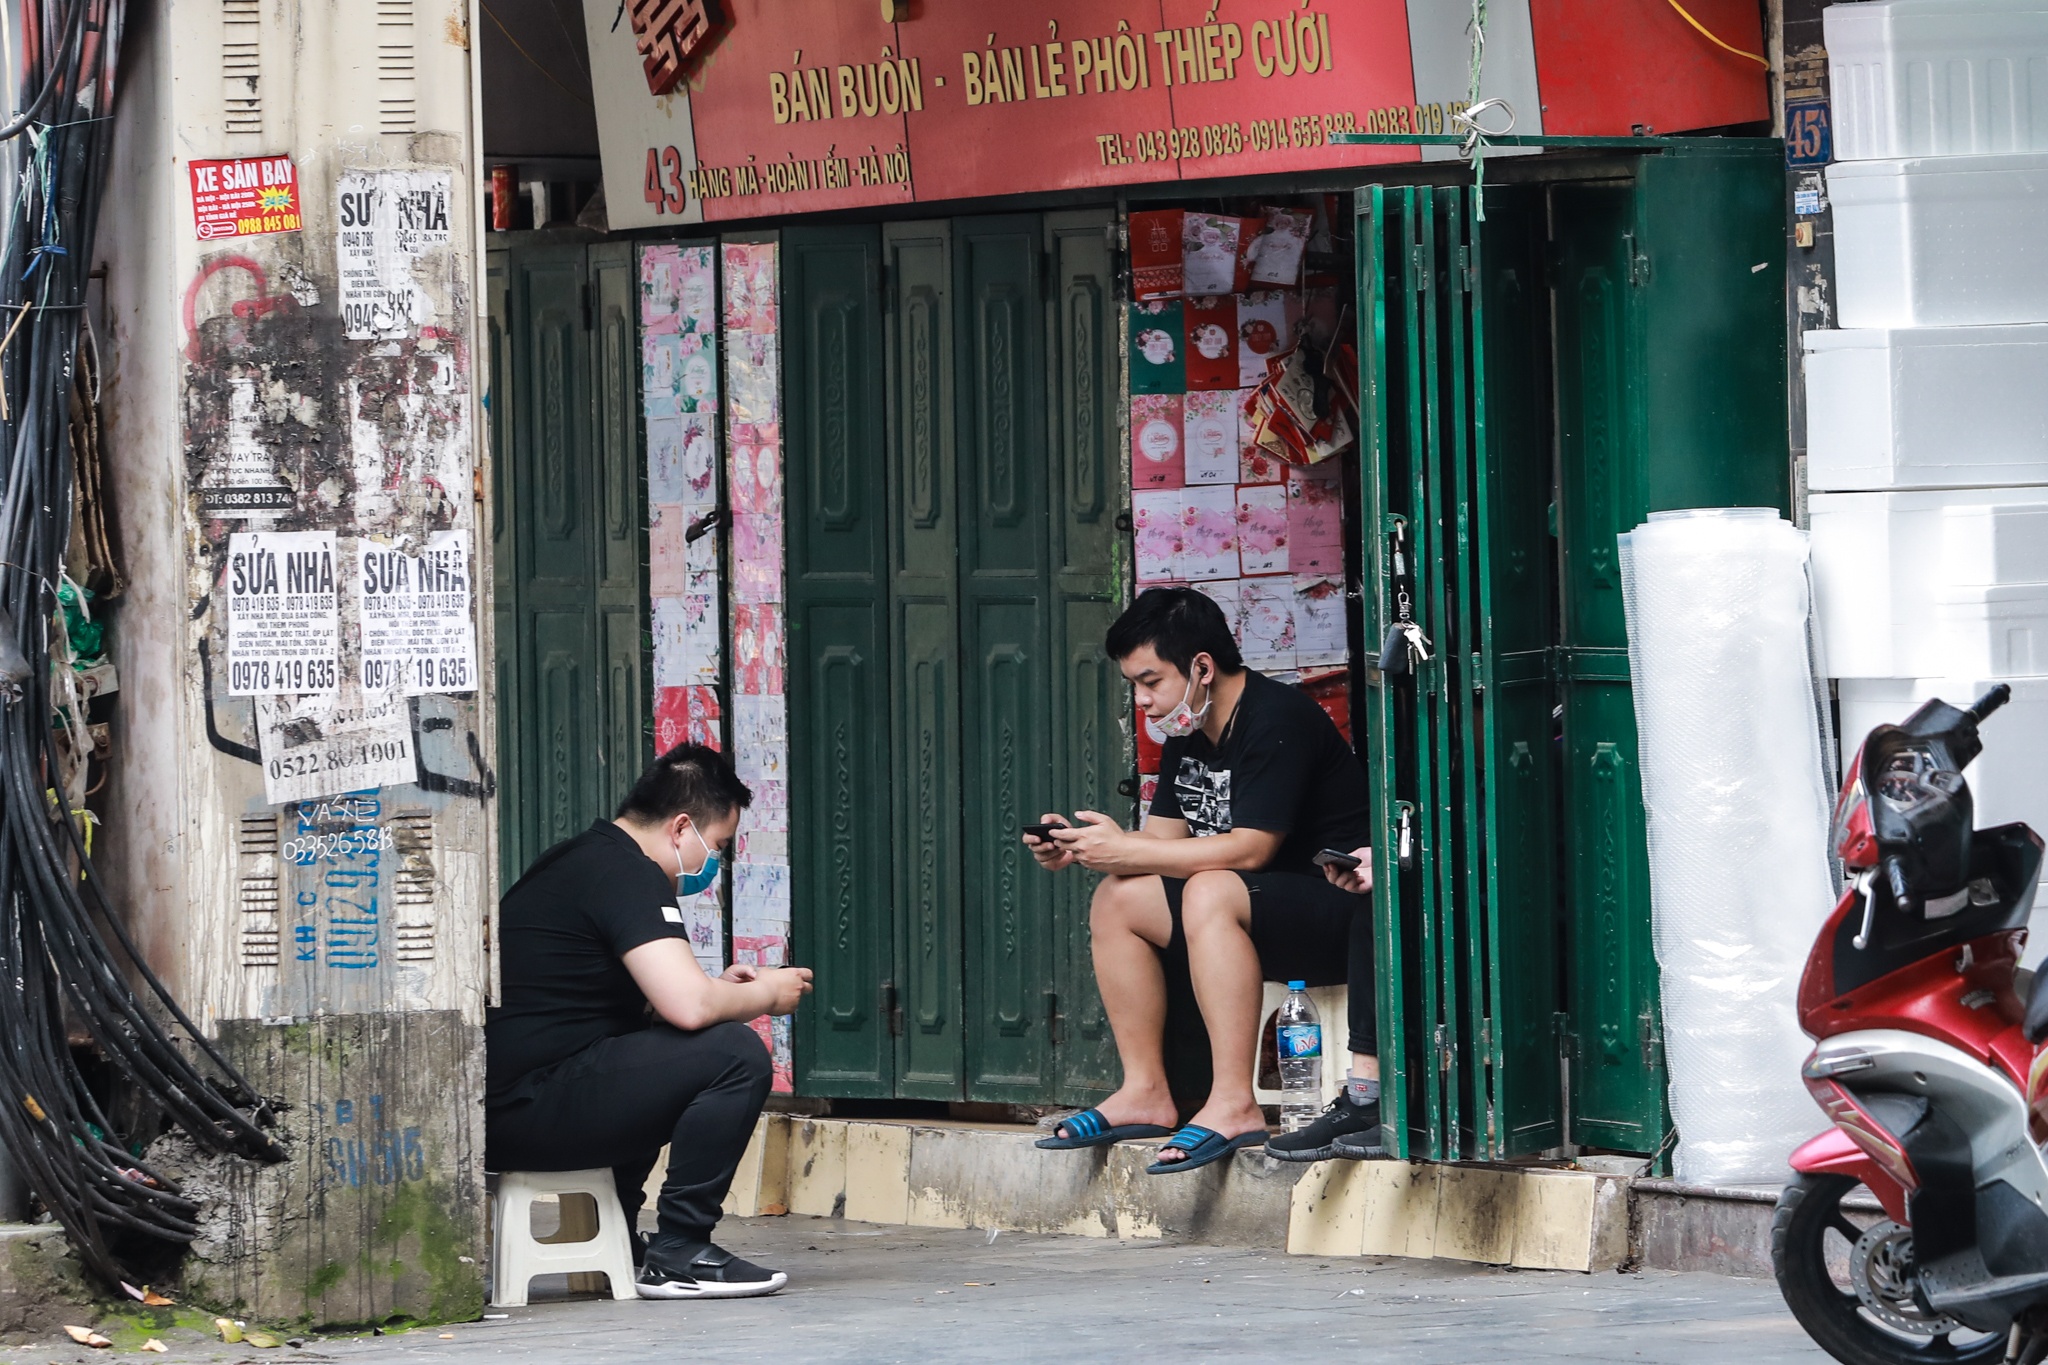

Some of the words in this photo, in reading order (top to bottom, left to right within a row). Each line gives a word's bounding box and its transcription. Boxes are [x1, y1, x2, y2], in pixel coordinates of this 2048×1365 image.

[769, 49, 831, 125] BÁN
[839, 46, 923, 119] BUÔN
[962, 33, 1026, 105] BÁN
[1030, 19, 1067, 98] LẺ
[1072, 19, 1149, 95] PHÔI
[1154, 0, 1243, 86] THIẾP
[1251, 0, 1332, 78] CƯỚI
[1096, 134, 1134, 166] TEL:
[1136, 130, 1168, 163] 043
[1169, 126, 1201, 159] 928
[1203, 122, 1242, 156] 0826
[1250, 118, 1289, 151] 0914
[1291, 115, 1322, 149] 655
[1324, 111, 1355, 143] 888
[1367, 105, 1411, 134] 0983
[1414, 102, 1443, 134] 019
[195, 167, 219, 193] XE
[222, 159, 259, 190] SÂN
[261, 159, 293, 186] BAY
[643, 145, 687, 215] 43
[688, 160, 731, 200] HÀNG
[734, 154, 760, 196] MÃ
[765, 152, 810, 193] HOÀN
[858, 145, 883, 186] HÀ
[883, 143, 911, 192] NỘI
[238, 217, 262, 234] 0988
[264, 215, 282, 232] 845
[283, 213, 301, 230] 081
[224, 493, 251, 504] 0382
[253, 493, 273, 503] 813
[232, 534, 279, 596] SỬA
[287, 541, 334, 594] NHÀ
[418, 541, 466, 593] NHÀ
[232, 597, 249, 611] 0978
[266, 596, 280, 611] 635
[286, 595, 303, 610] 0978
[320, 595, 333, 609] 635
[233, 661, 269, 690] 0978
[275, 660, 302, 689] 419
[307, 659, 334, 689] 635
[440, 657, 466, 687] 635
